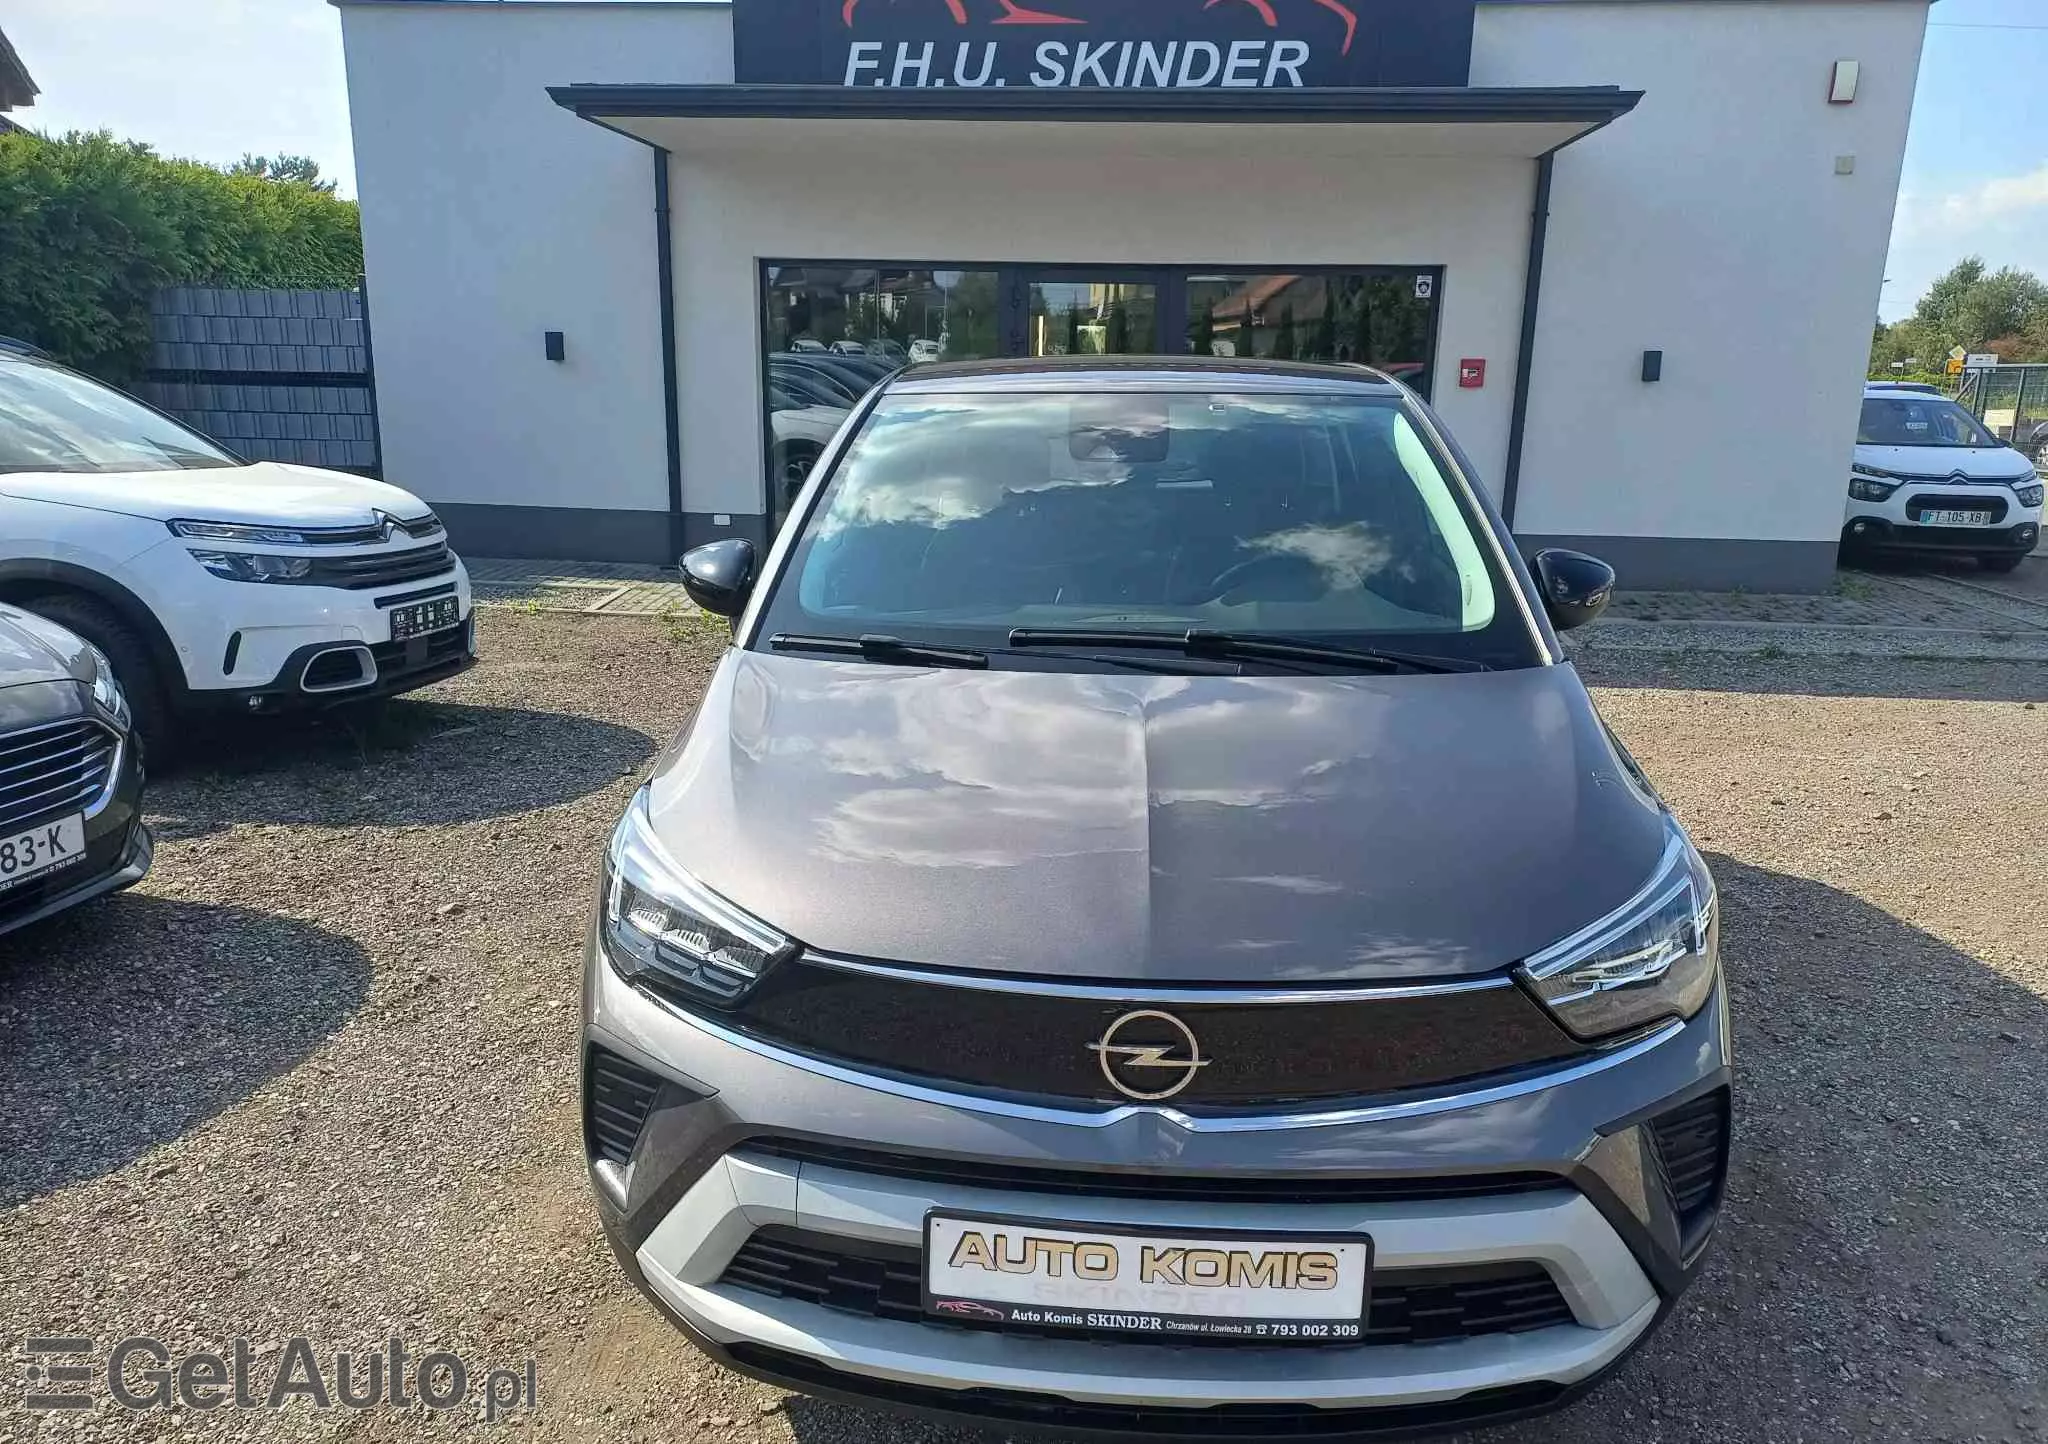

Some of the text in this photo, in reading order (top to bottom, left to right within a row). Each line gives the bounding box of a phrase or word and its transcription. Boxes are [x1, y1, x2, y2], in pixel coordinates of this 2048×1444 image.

[843, 40, 1310, 87] F.H.U. SKINDER
[948, 1231, 1338, 1290] AUTO KOMIS
[1011, 1309, 1041, 1322] Auto
[1044, 1311, 1083, 1325] Komis
[1087, 1313, 1162, 1330] SKINDER
[1271, 1324, 1298, 1336] 793
[1302, 1325, 1329, 1336] 002
[1332, 1325, 1359, 1336] 309
